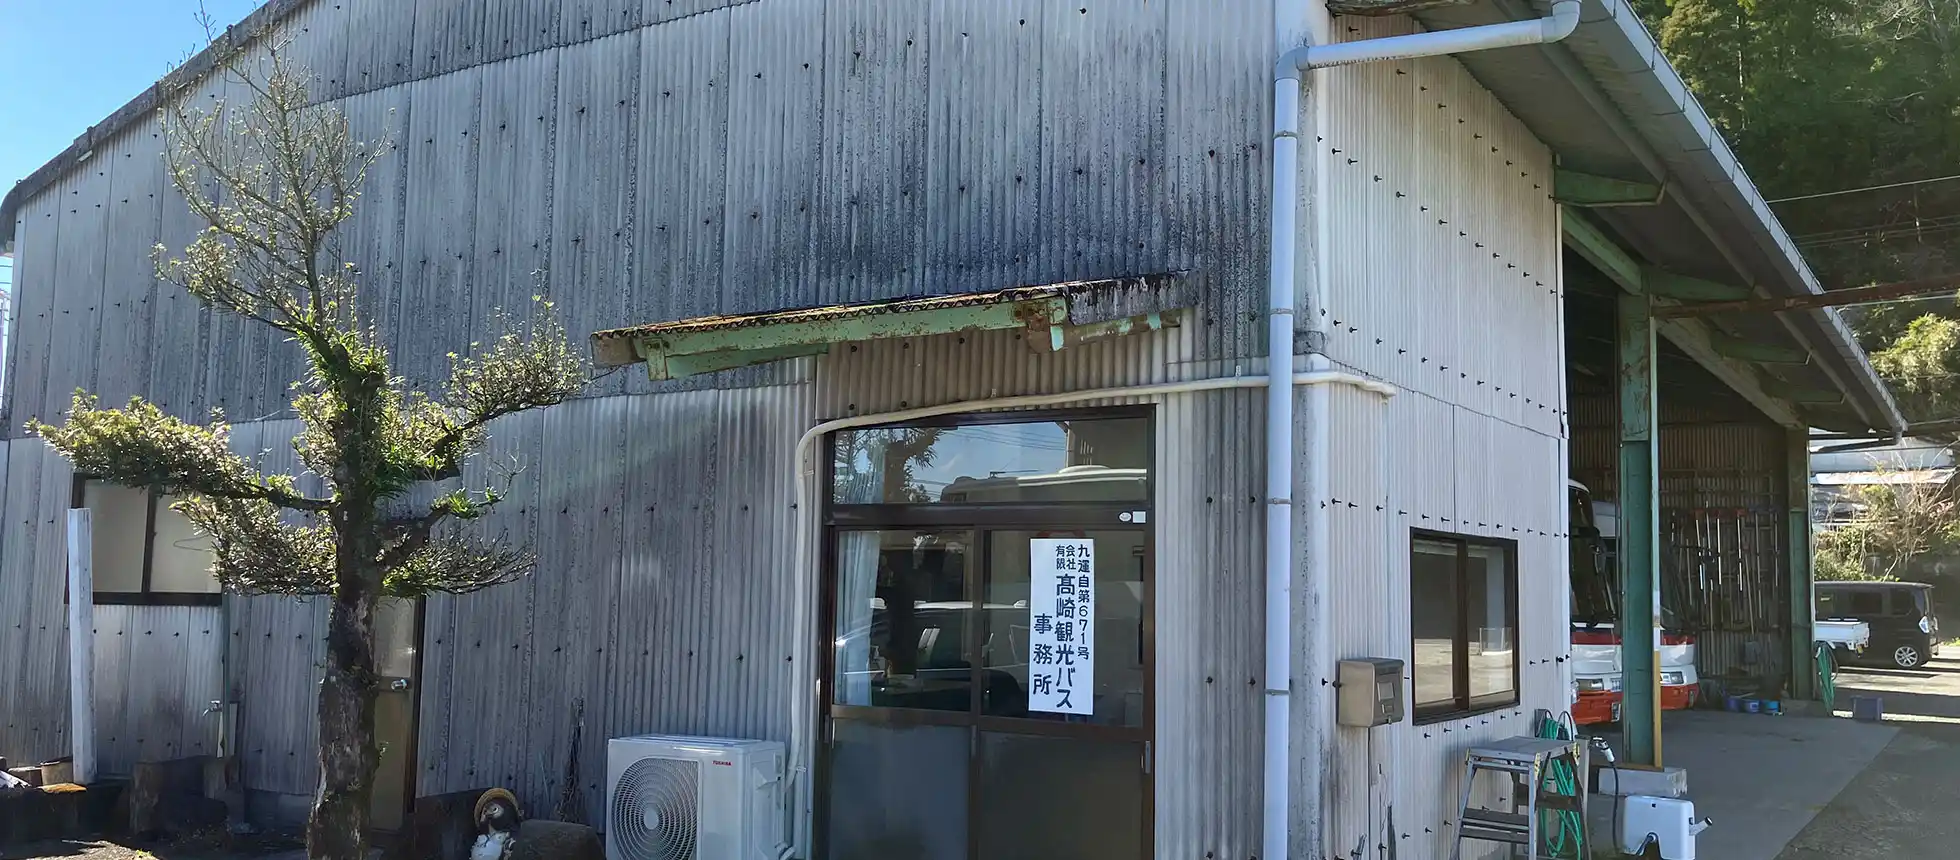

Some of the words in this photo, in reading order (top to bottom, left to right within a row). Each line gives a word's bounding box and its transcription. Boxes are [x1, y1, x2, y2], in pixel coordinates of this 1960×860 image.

[1077, 543, 1091, 660] 九運自第671号
[1033, 613, 1053, 695] 事務所
